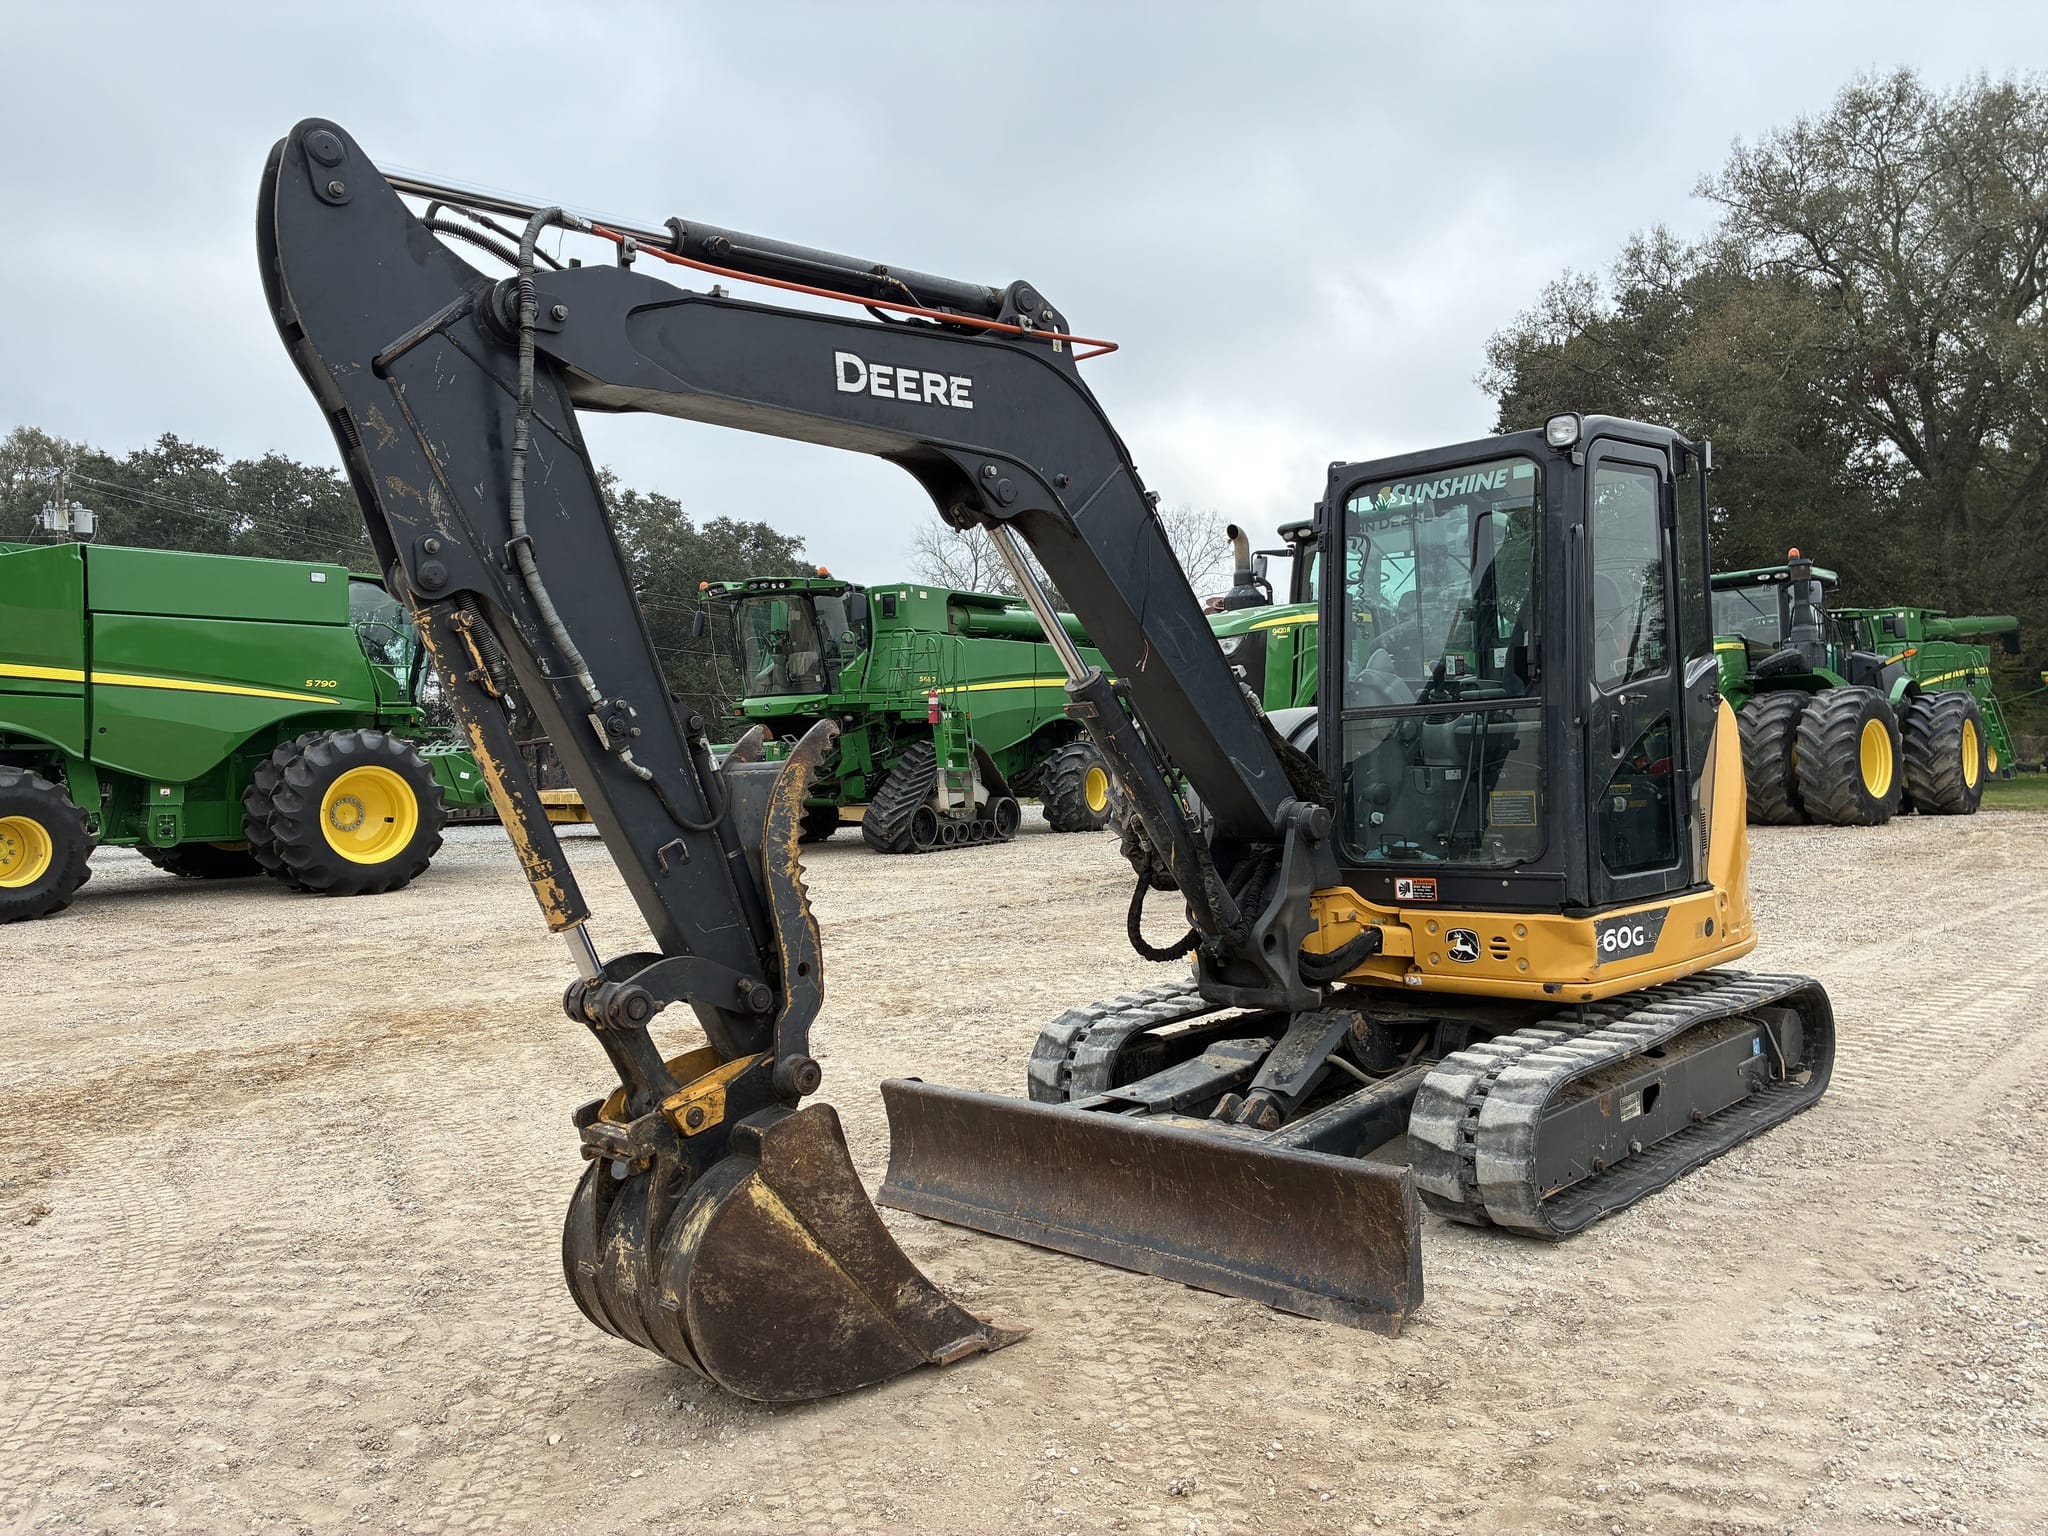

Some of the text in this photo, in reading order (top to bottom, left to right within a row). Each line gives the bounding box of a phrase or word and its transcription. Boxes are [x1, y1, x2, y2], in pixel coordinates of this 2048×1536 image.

[835, 351, 974, 409] DEERE
[1391, 468, 1509, 504] SUNSHINE
[305, 679, 337, 688] S790
[1603, 926, 1644, 952] 60G
